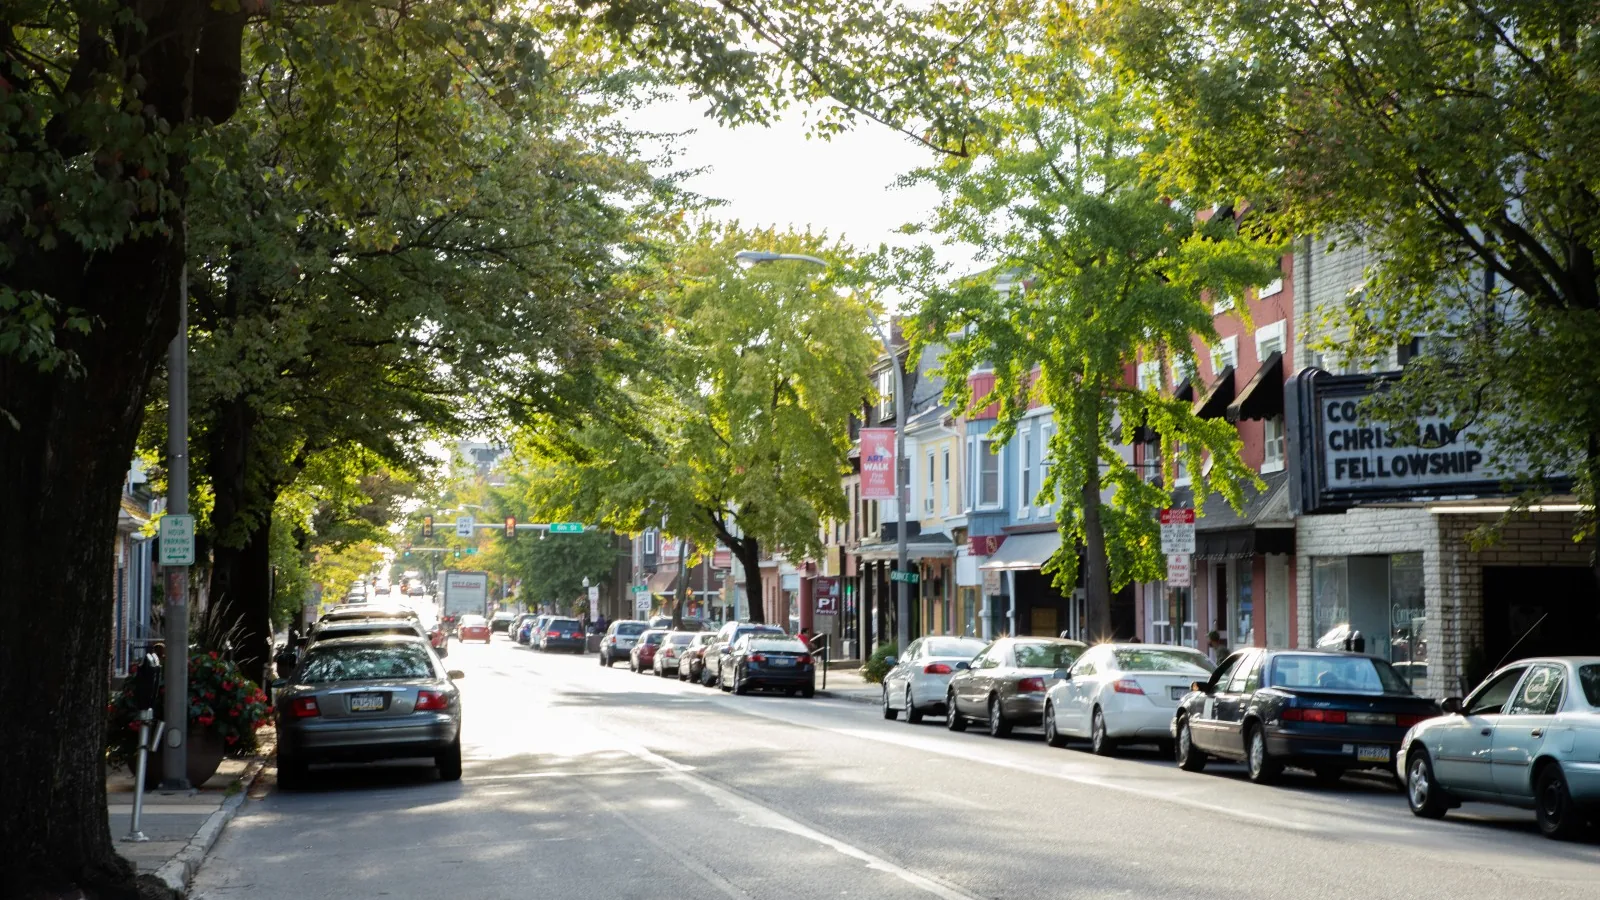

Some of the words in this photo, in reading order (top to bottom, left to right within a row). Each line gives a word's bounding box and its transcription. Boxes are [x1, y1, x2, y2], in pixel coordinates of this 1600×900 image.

[1329, 422, 1458, 451] CHRISIAN
[864, 463, 889, 471] WALK
[1334, 450, 1482, 480] FELLOWSHIP
[911, 573, 920, 583] ST
[638, 601, 650, 609] 25
[818, 598, 830, 608] P
